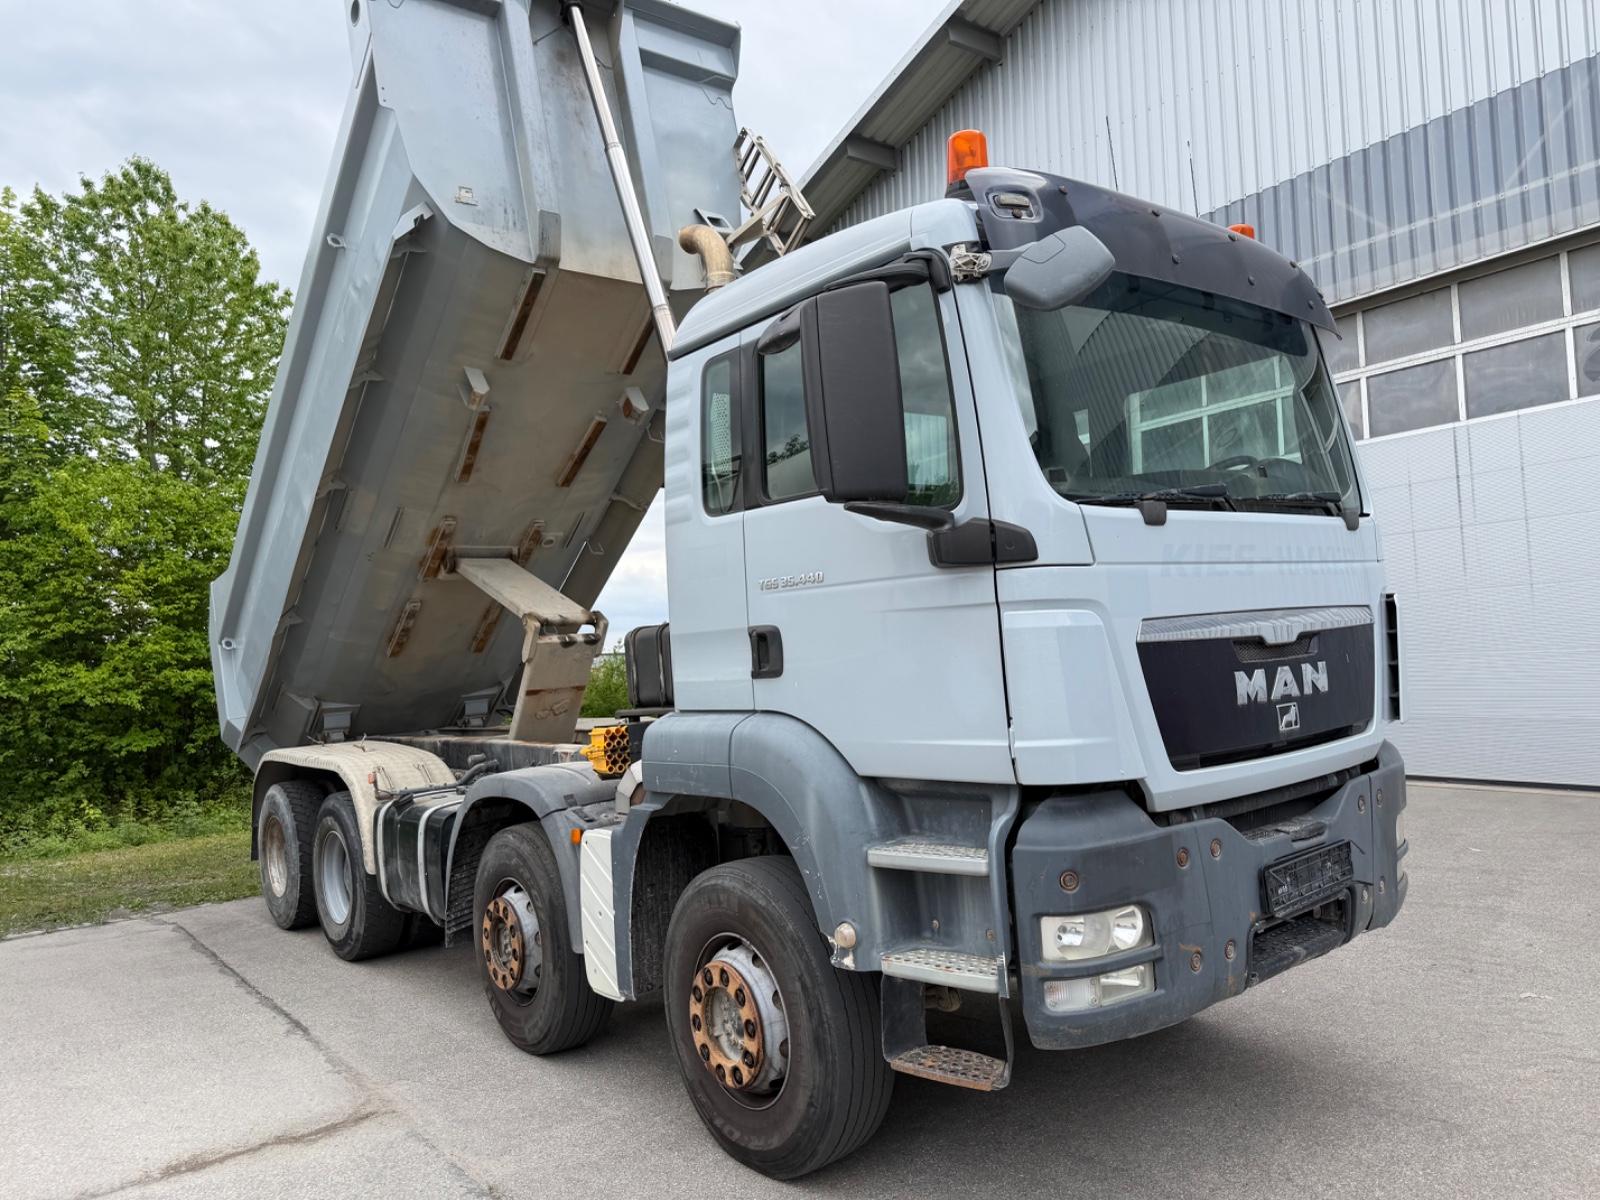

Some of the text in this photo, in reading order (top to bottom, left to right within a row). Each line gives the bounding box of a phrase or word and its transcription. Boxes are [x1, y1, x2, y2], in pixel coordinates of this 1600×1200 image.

[759, 571, 824, 591] TGS 35.440
[1234, 661, 1329, 705] MAN
